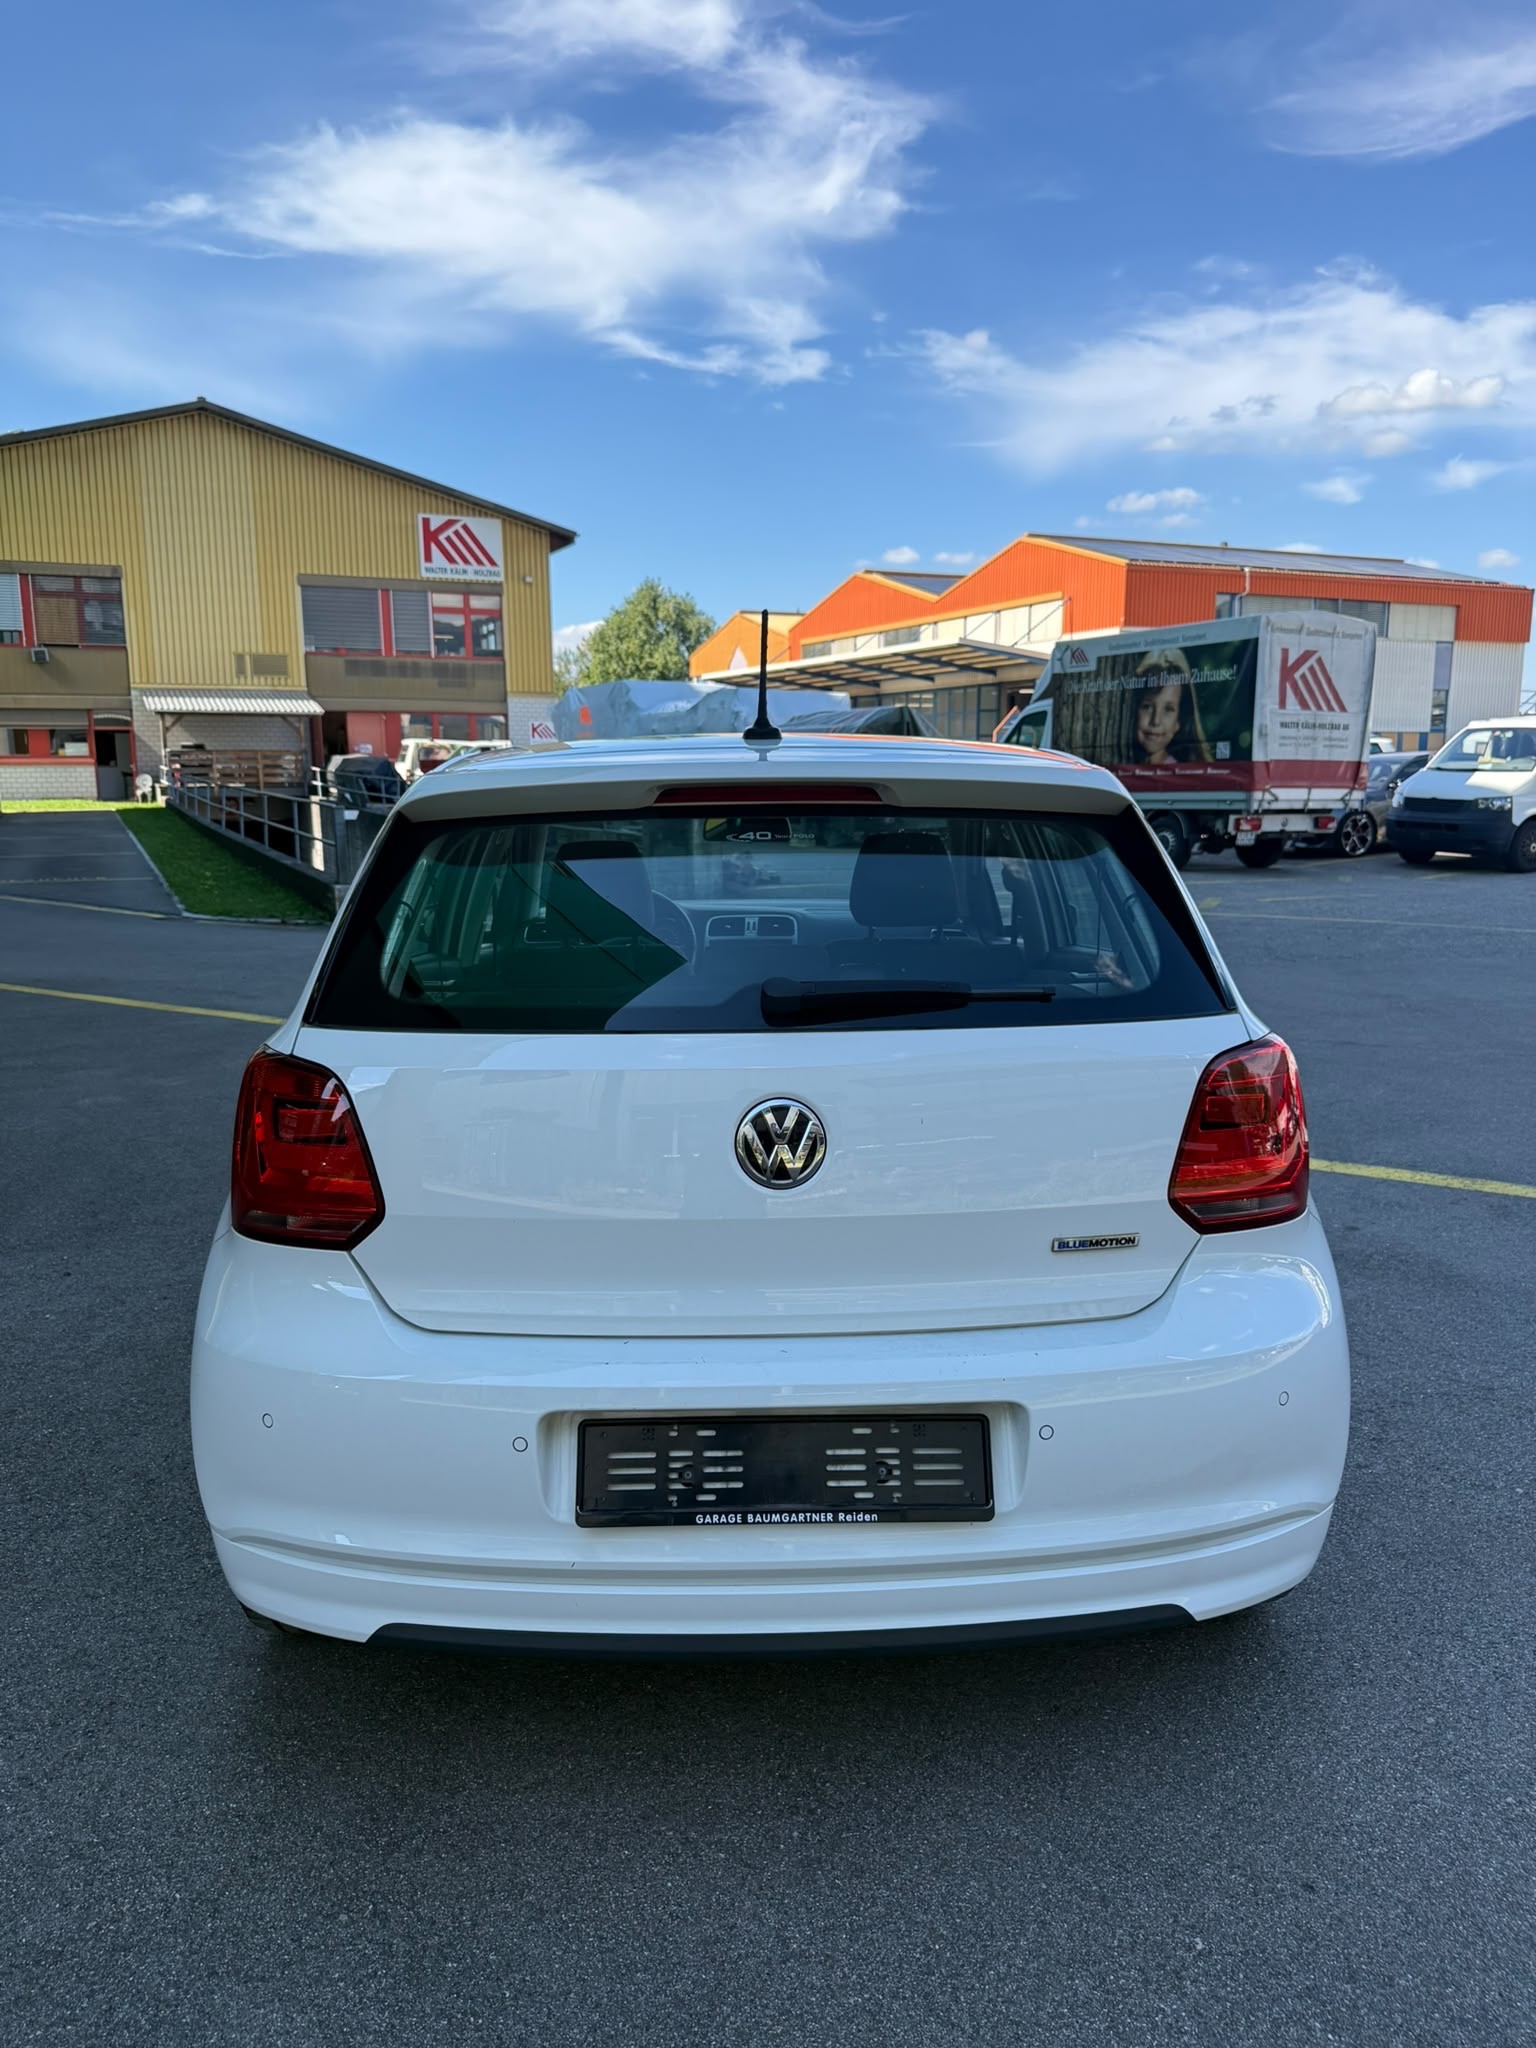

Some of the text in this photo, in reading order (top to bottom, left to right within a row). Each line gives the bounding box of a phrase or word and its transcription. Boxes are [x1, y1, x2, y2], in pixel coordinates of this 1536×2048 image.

[1120, 673, 1146, 690] Natur
[1147, 671, 1158, 688] in
[1159, 669, 1189, 686] Ihrem
[1190, 663, 1238, 684] Zuhause!
[793, 832, 815, 840] POLO
[1057, 1235, 1136, 1250] BLUEMOTION
[695, 1511, 878, 1525] GARAGE BAUMGARTNER Reiden
